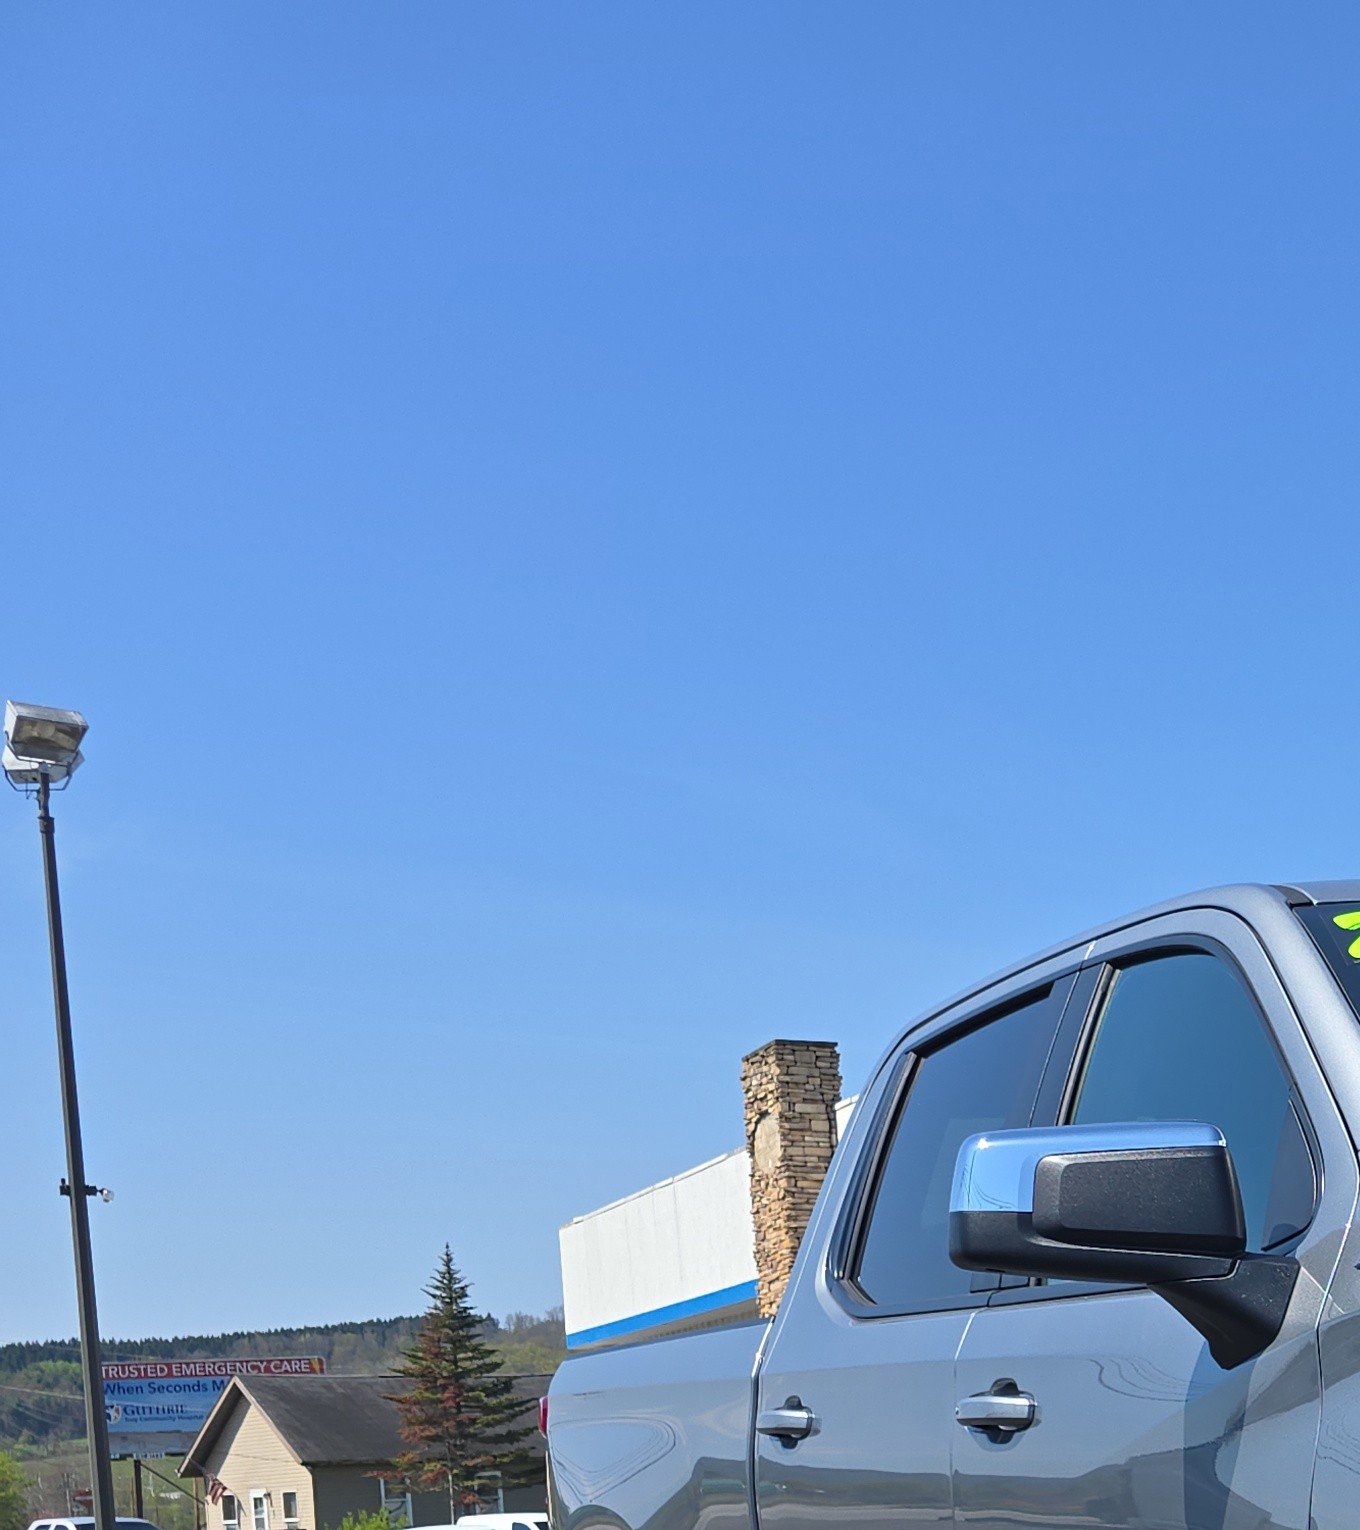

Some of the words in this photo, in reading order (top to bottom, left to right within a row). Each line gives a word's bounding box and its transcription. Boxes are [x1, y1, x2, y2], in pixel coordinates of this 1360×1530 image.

[102, 1363, 169, 1378] TRUSTED
[172, 1361, 267, 1376] EMERGENCY
[270, 1359, 310, 1373] CARE
[147, 1380, 208, 1394] Seconds
